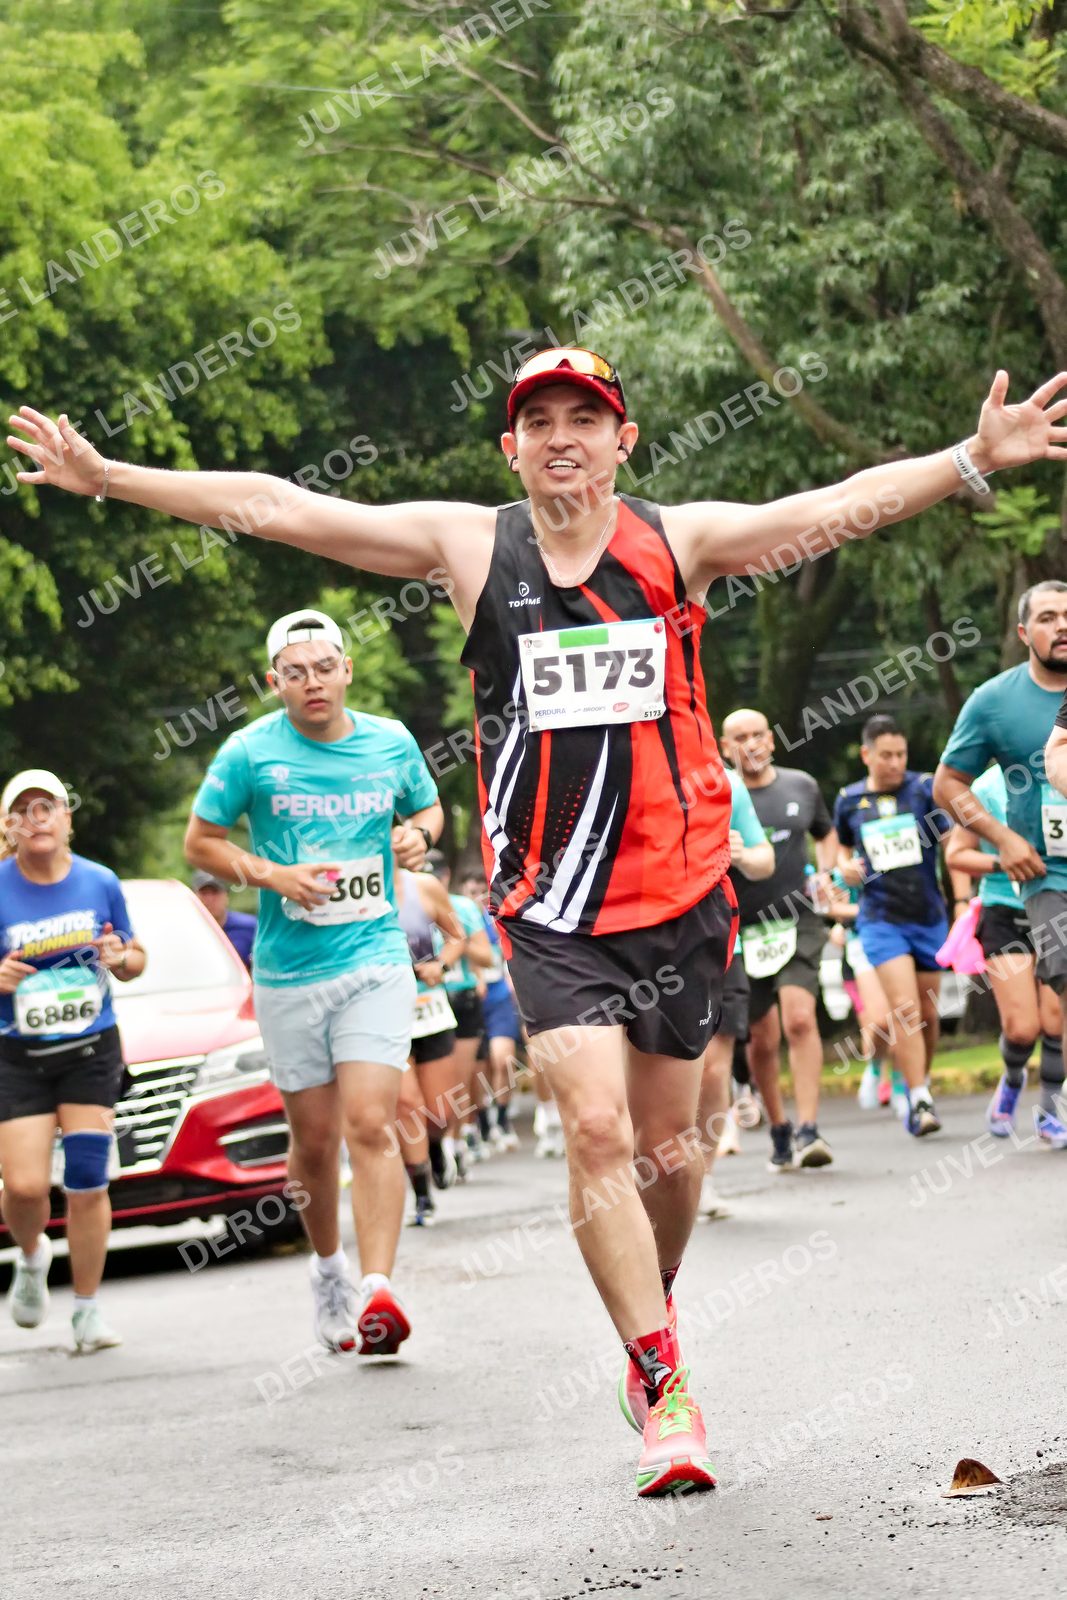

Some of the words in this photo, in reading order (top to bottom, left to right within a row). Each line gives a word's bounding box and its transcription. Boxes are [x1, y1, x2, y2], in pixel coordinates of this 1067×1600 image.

[533, 648, 656, 696] 5173
[535, 707, 566, 717] PERDURA
[644, 710, 662, 718] 5173
[271, 789, 393, 816] PERDURA
[1049, 819, 1067, 839] 3
[8, 910, 97, 948] TOCHITOS
[23, 931, 94, 957] RUNNERS
[26, 1001, 96, 1028] 6886
